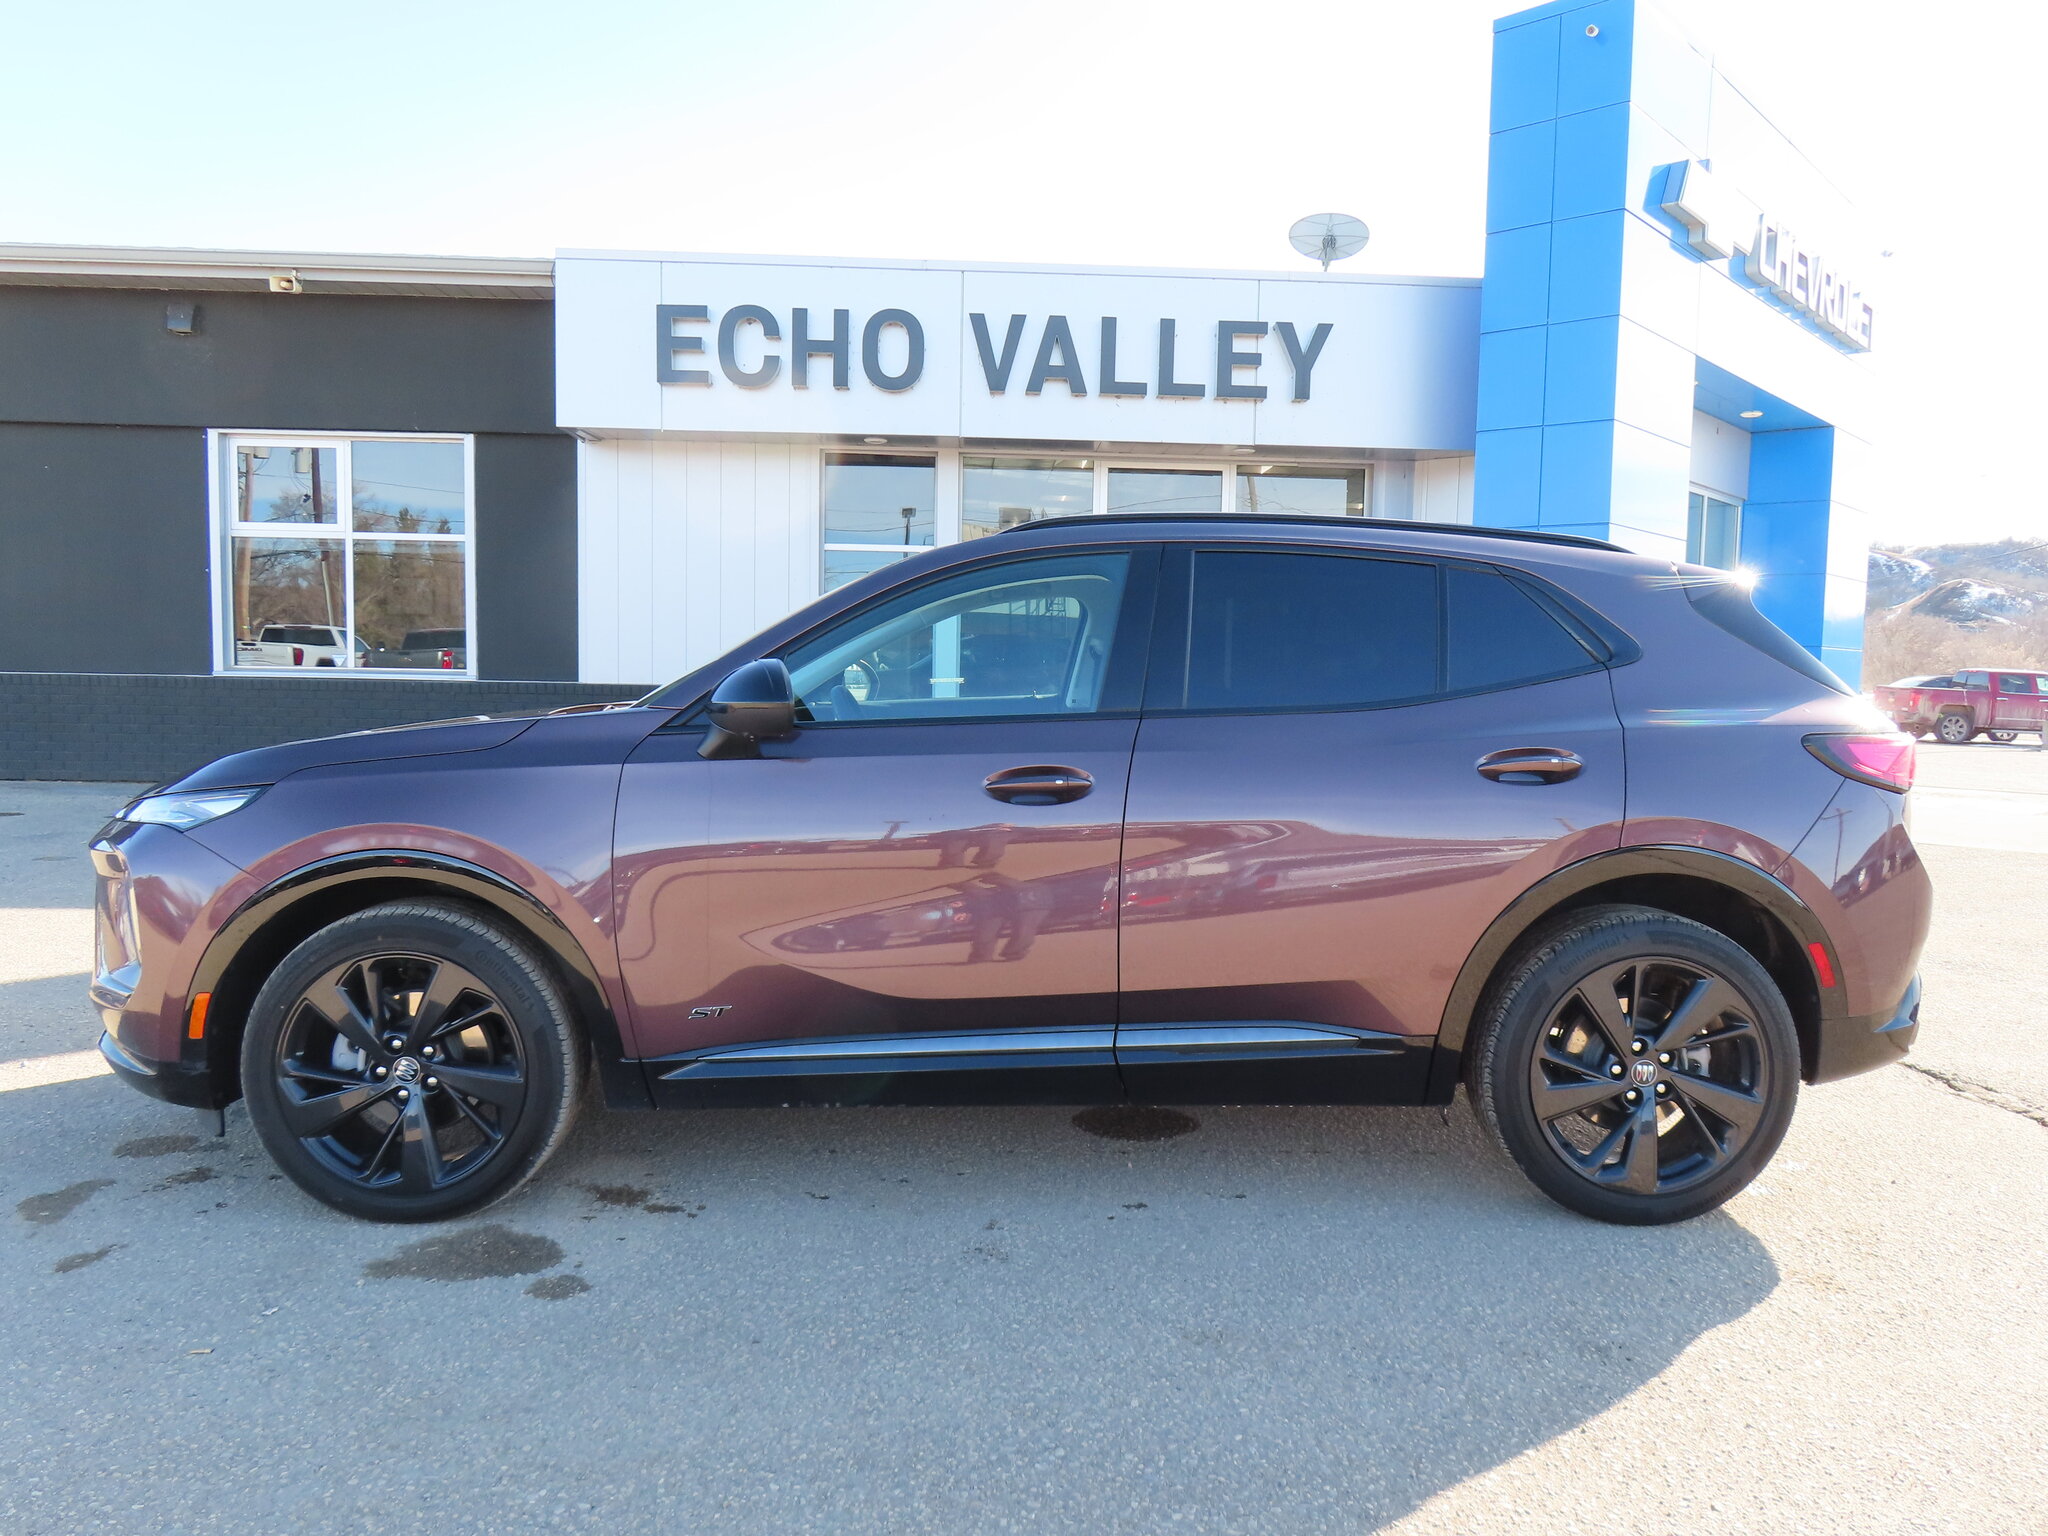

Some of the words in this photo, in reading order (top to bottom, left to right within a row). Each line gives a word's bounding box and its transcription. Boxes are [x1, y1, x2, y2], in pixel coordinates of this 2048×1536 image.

[1748, 212, 1873, 353] CHEVROLE
[656, 303, 926, 393] ECHO
[968, 312, 1334, 403] VALLEY
[687, 1005, 733, 1020] ST
